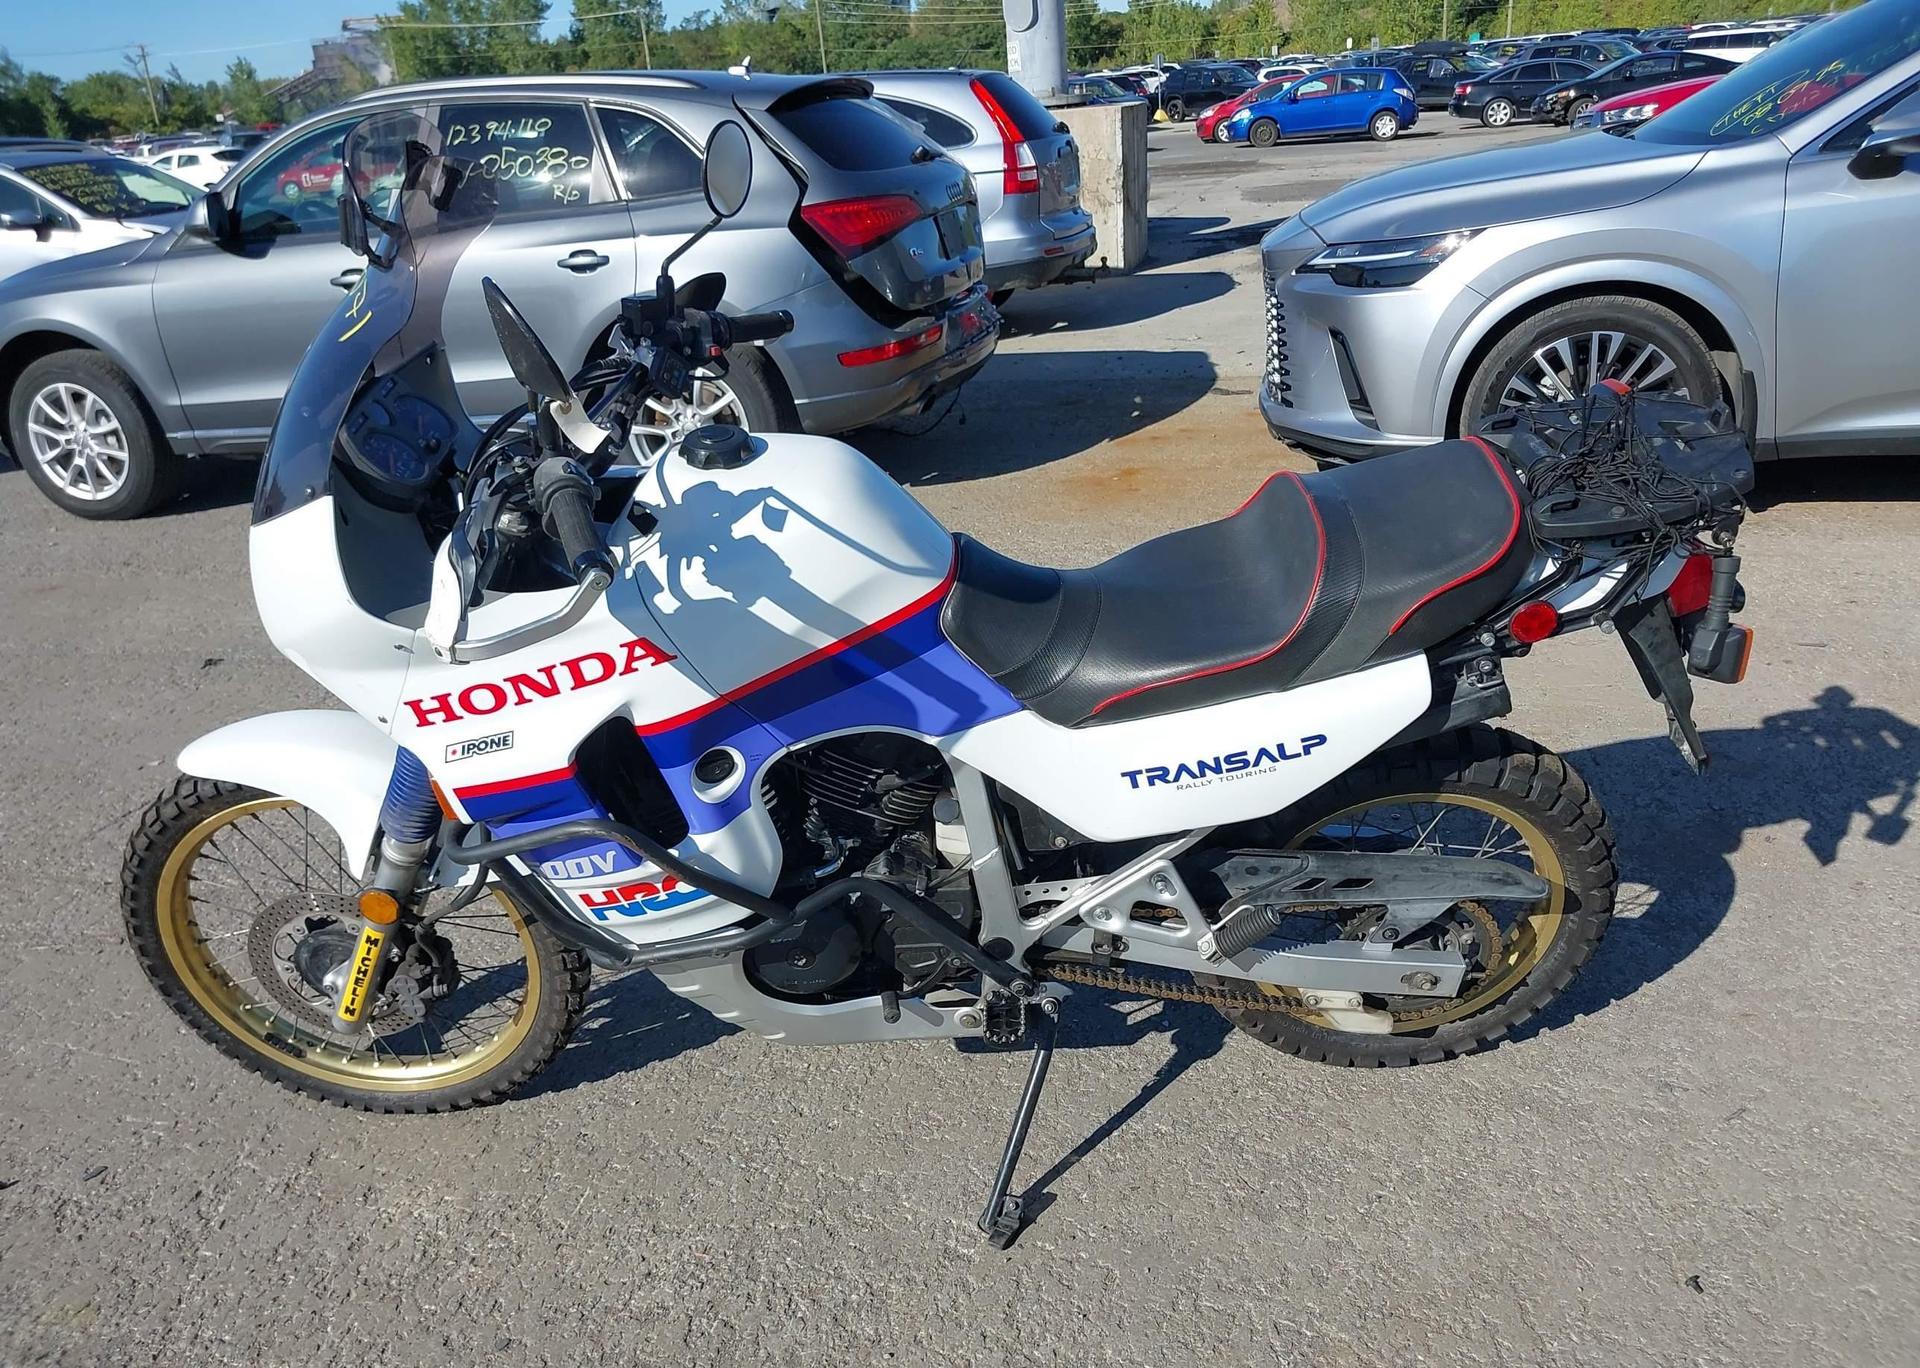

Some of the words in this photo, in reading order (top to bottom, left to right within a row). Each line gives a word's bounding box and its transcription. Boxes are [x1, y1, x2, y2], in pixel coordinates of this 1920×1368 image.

[1715, 82, 1778, 127] THEFT
[404, 636, 678, 728] HONDA
[461, 734, 511, 756] IPONE
[1120, 733, 1328, 789] TRANSALP
[1176, 778, 1214, 791] RALLY
[1218, 766, 1278, 785] TOURING
[539, 850, 617, 880] 00V
[343, 934, 380, 1018] MICHELIN
